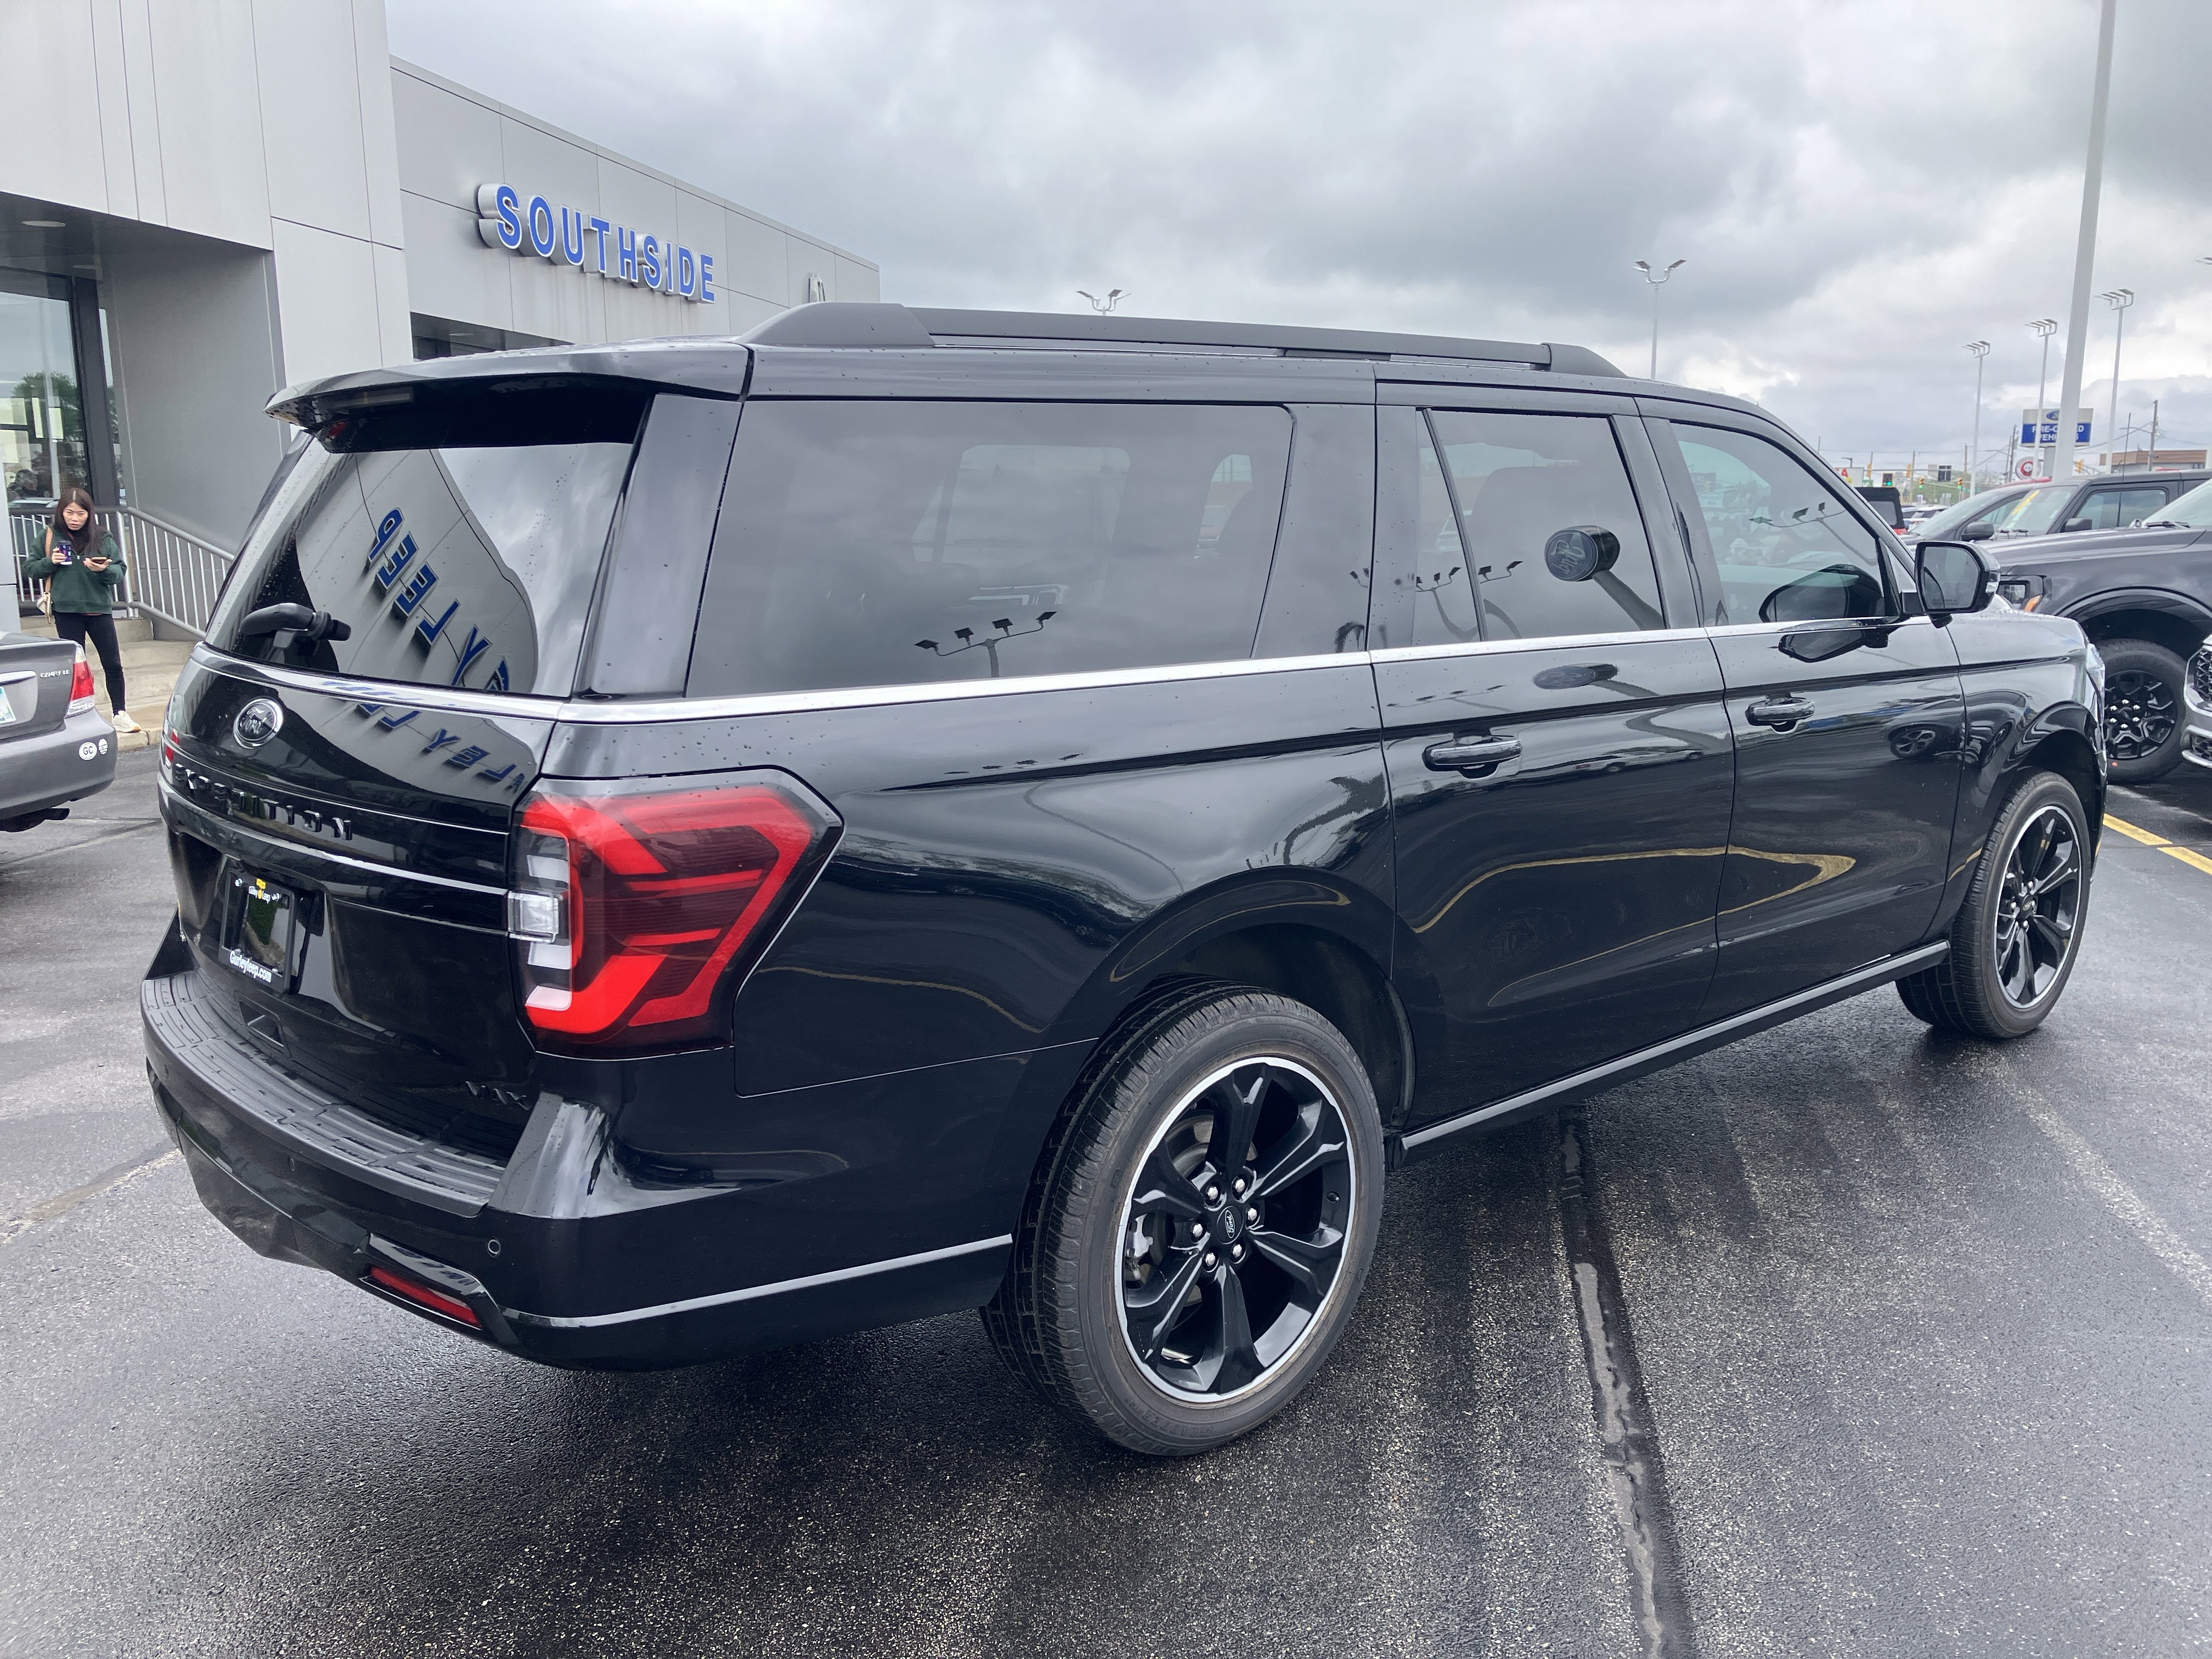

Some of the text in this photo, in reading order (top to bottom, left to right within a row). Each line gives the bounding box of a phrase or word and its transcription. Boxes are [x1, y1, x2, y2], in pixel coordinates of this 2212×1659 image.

[494, 183, 715, 304] SOUTHSIDE
[83, 746, 93, 755] GC
[1226, 1214, 1234, 1234] Ford
